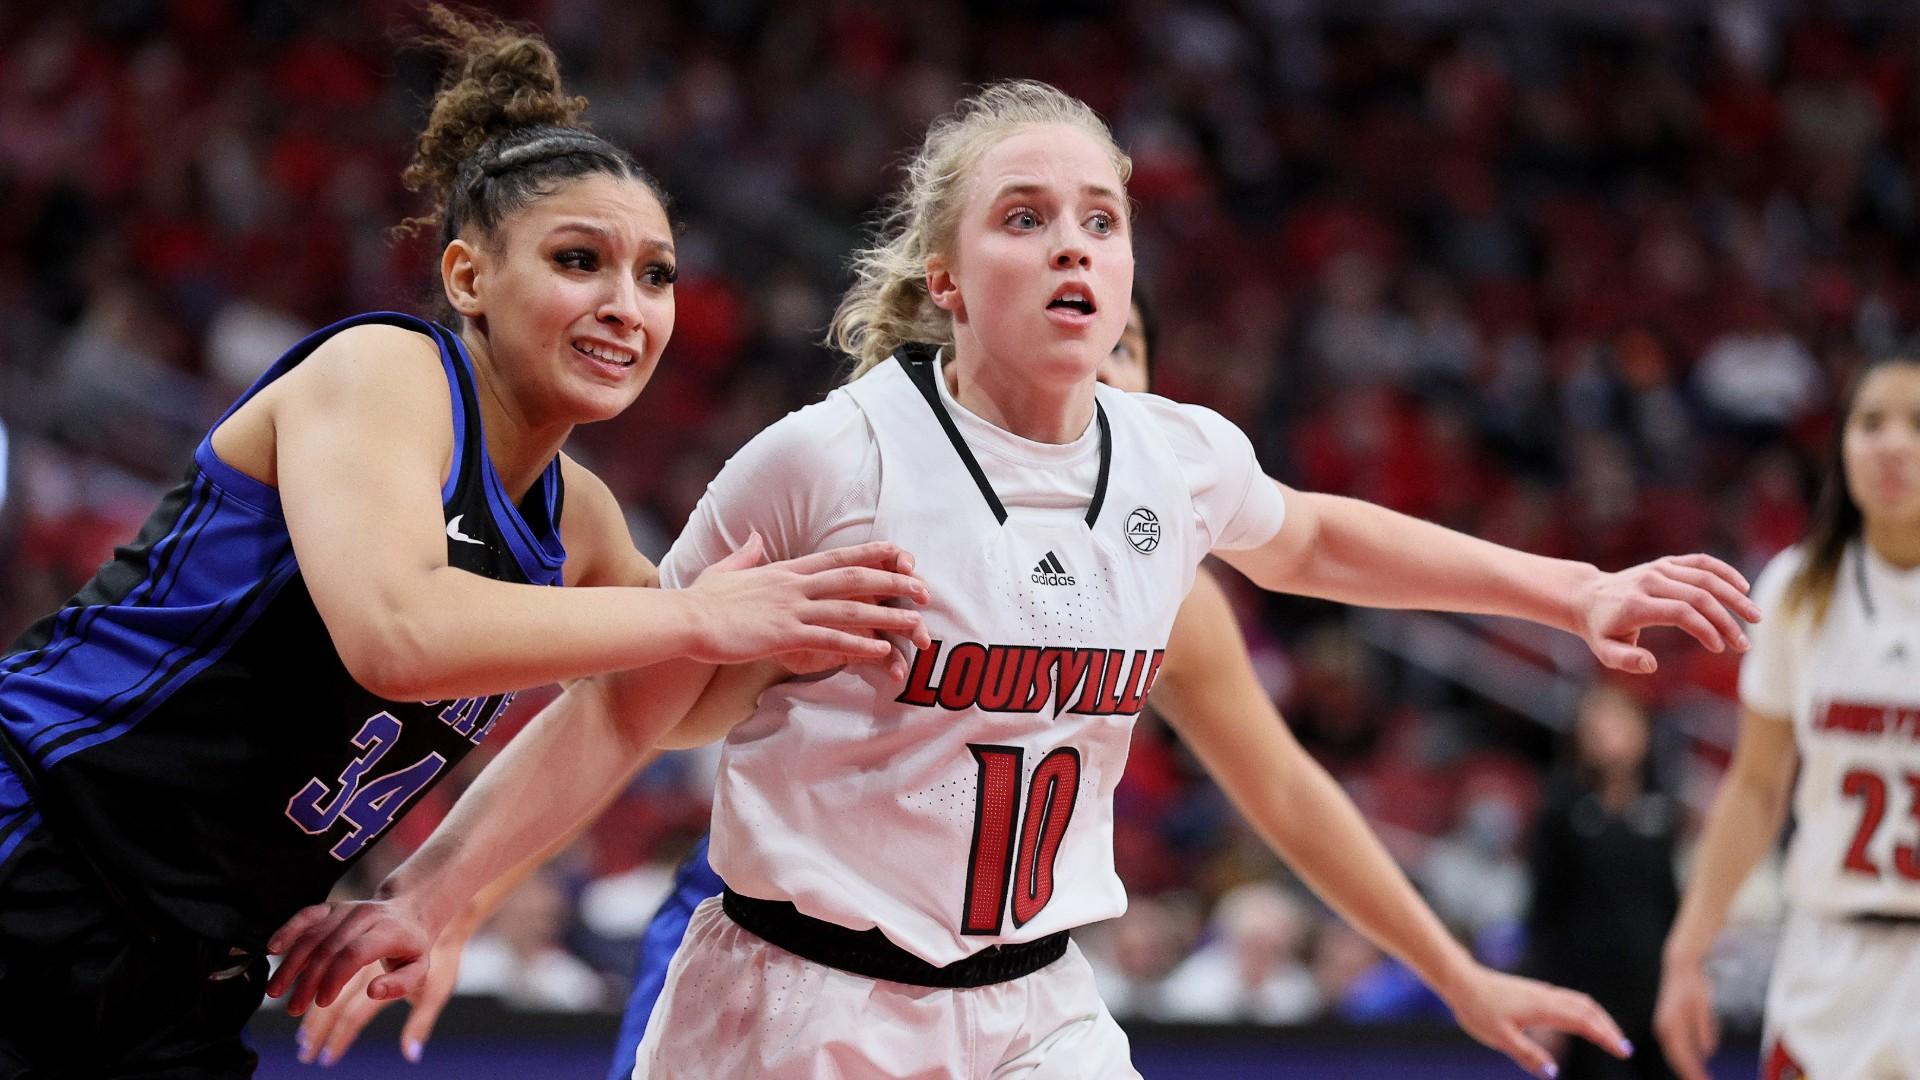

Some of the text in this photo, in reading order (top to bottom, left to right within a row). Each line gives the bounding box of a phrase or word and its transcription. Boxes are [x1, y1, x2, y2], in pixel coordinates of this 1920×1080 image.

[1131, 522, 1159, 533] ACC
[1031, 572, 1076, 586] adidas
[285, 710, 447, 862] 34
[961, 743, 1080, 935] 10
